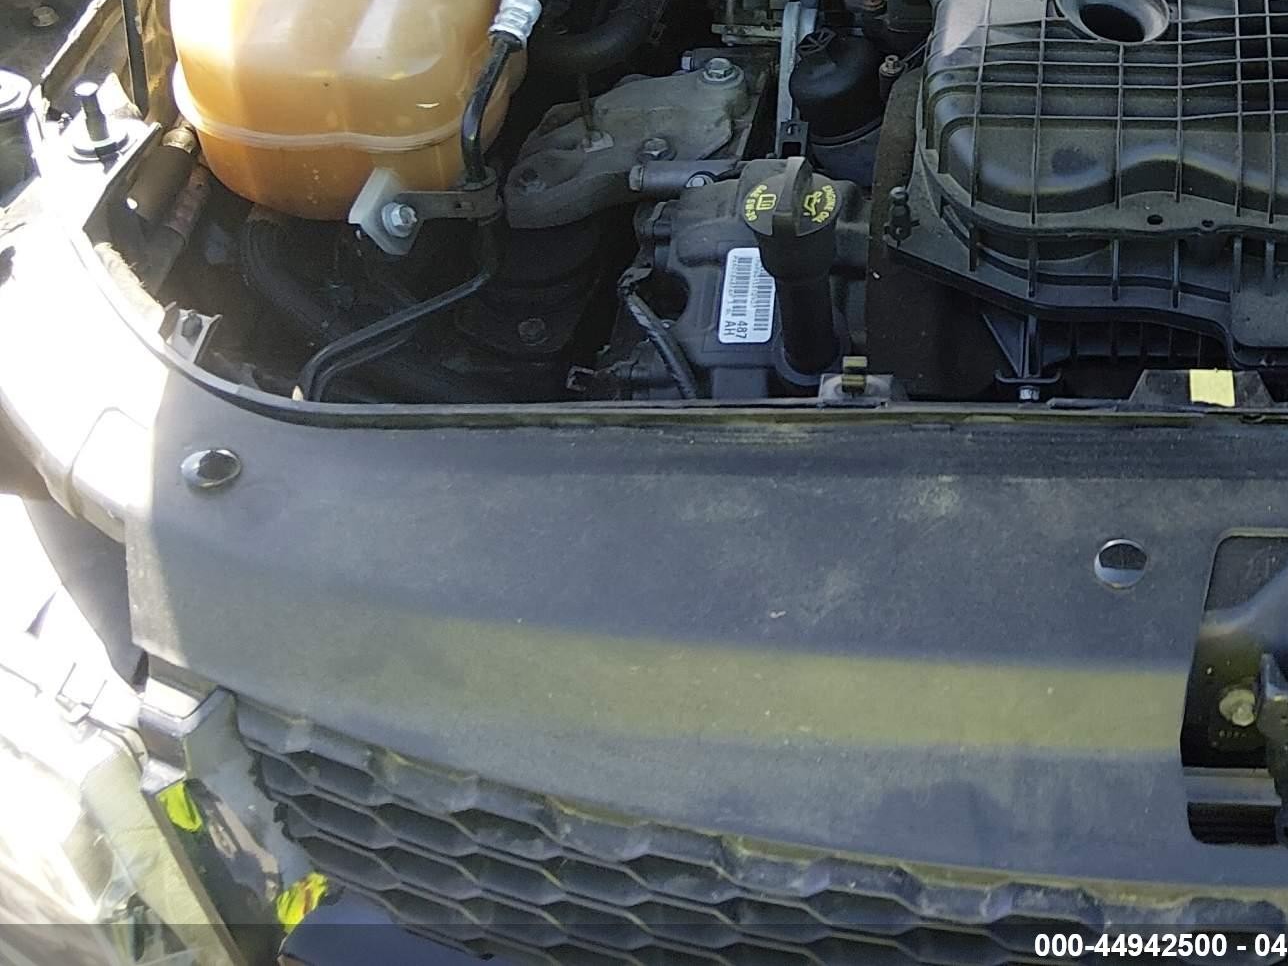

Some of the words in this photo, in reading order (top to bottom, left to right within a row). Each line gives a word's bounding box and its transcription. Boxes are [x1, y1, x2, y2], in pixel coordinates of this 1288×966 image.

[811, 211, 830, 223] OIL
[723, 320, 735, 337] AH
[735, 320, 748, 339] 487
